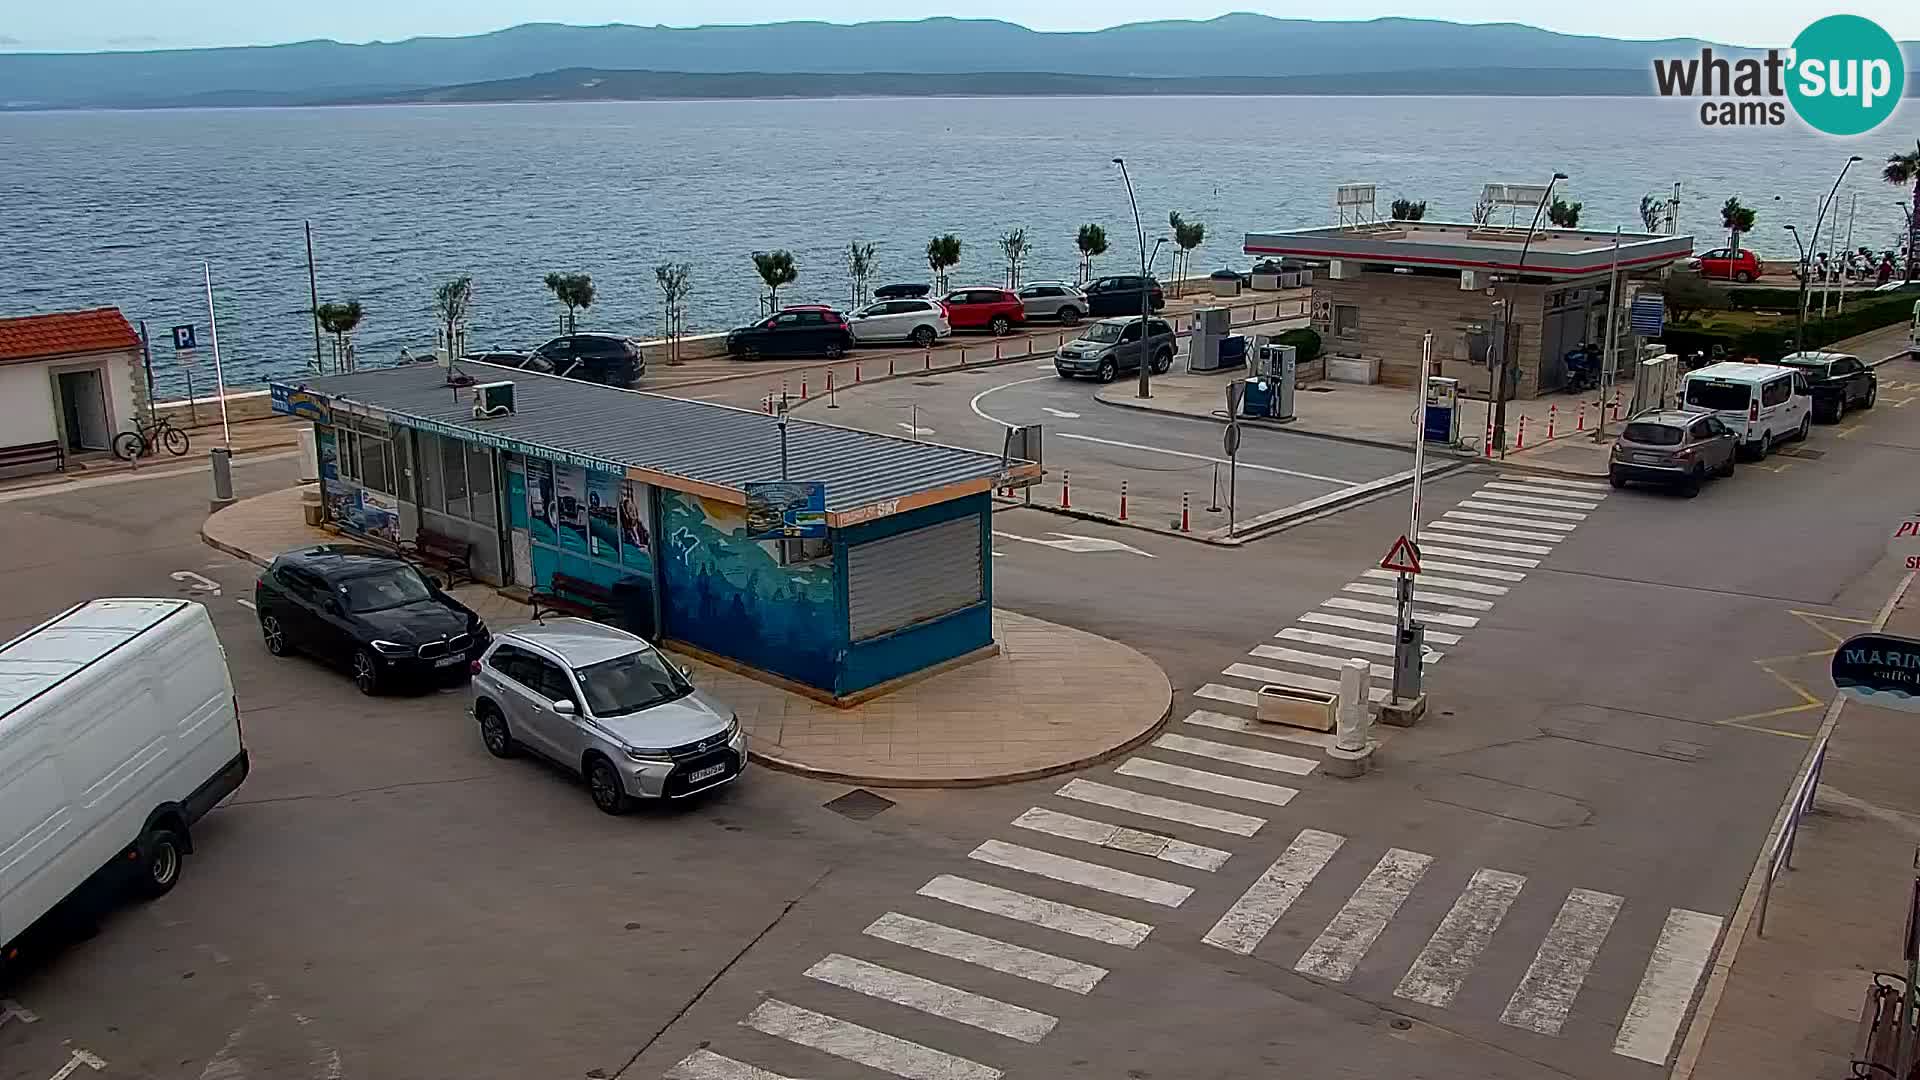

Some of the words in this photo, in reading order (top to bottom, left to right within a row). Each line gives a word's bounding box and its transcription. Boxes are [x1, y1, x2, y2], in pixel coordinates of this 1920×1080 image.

[179, 329, 190, 346] P
[519, 443, 534, 455] BUS
[534, 446, 567, 462] STATION
[569, 454, 594, 468] TICKET
[595, 461, 623, 475] OFFICE
